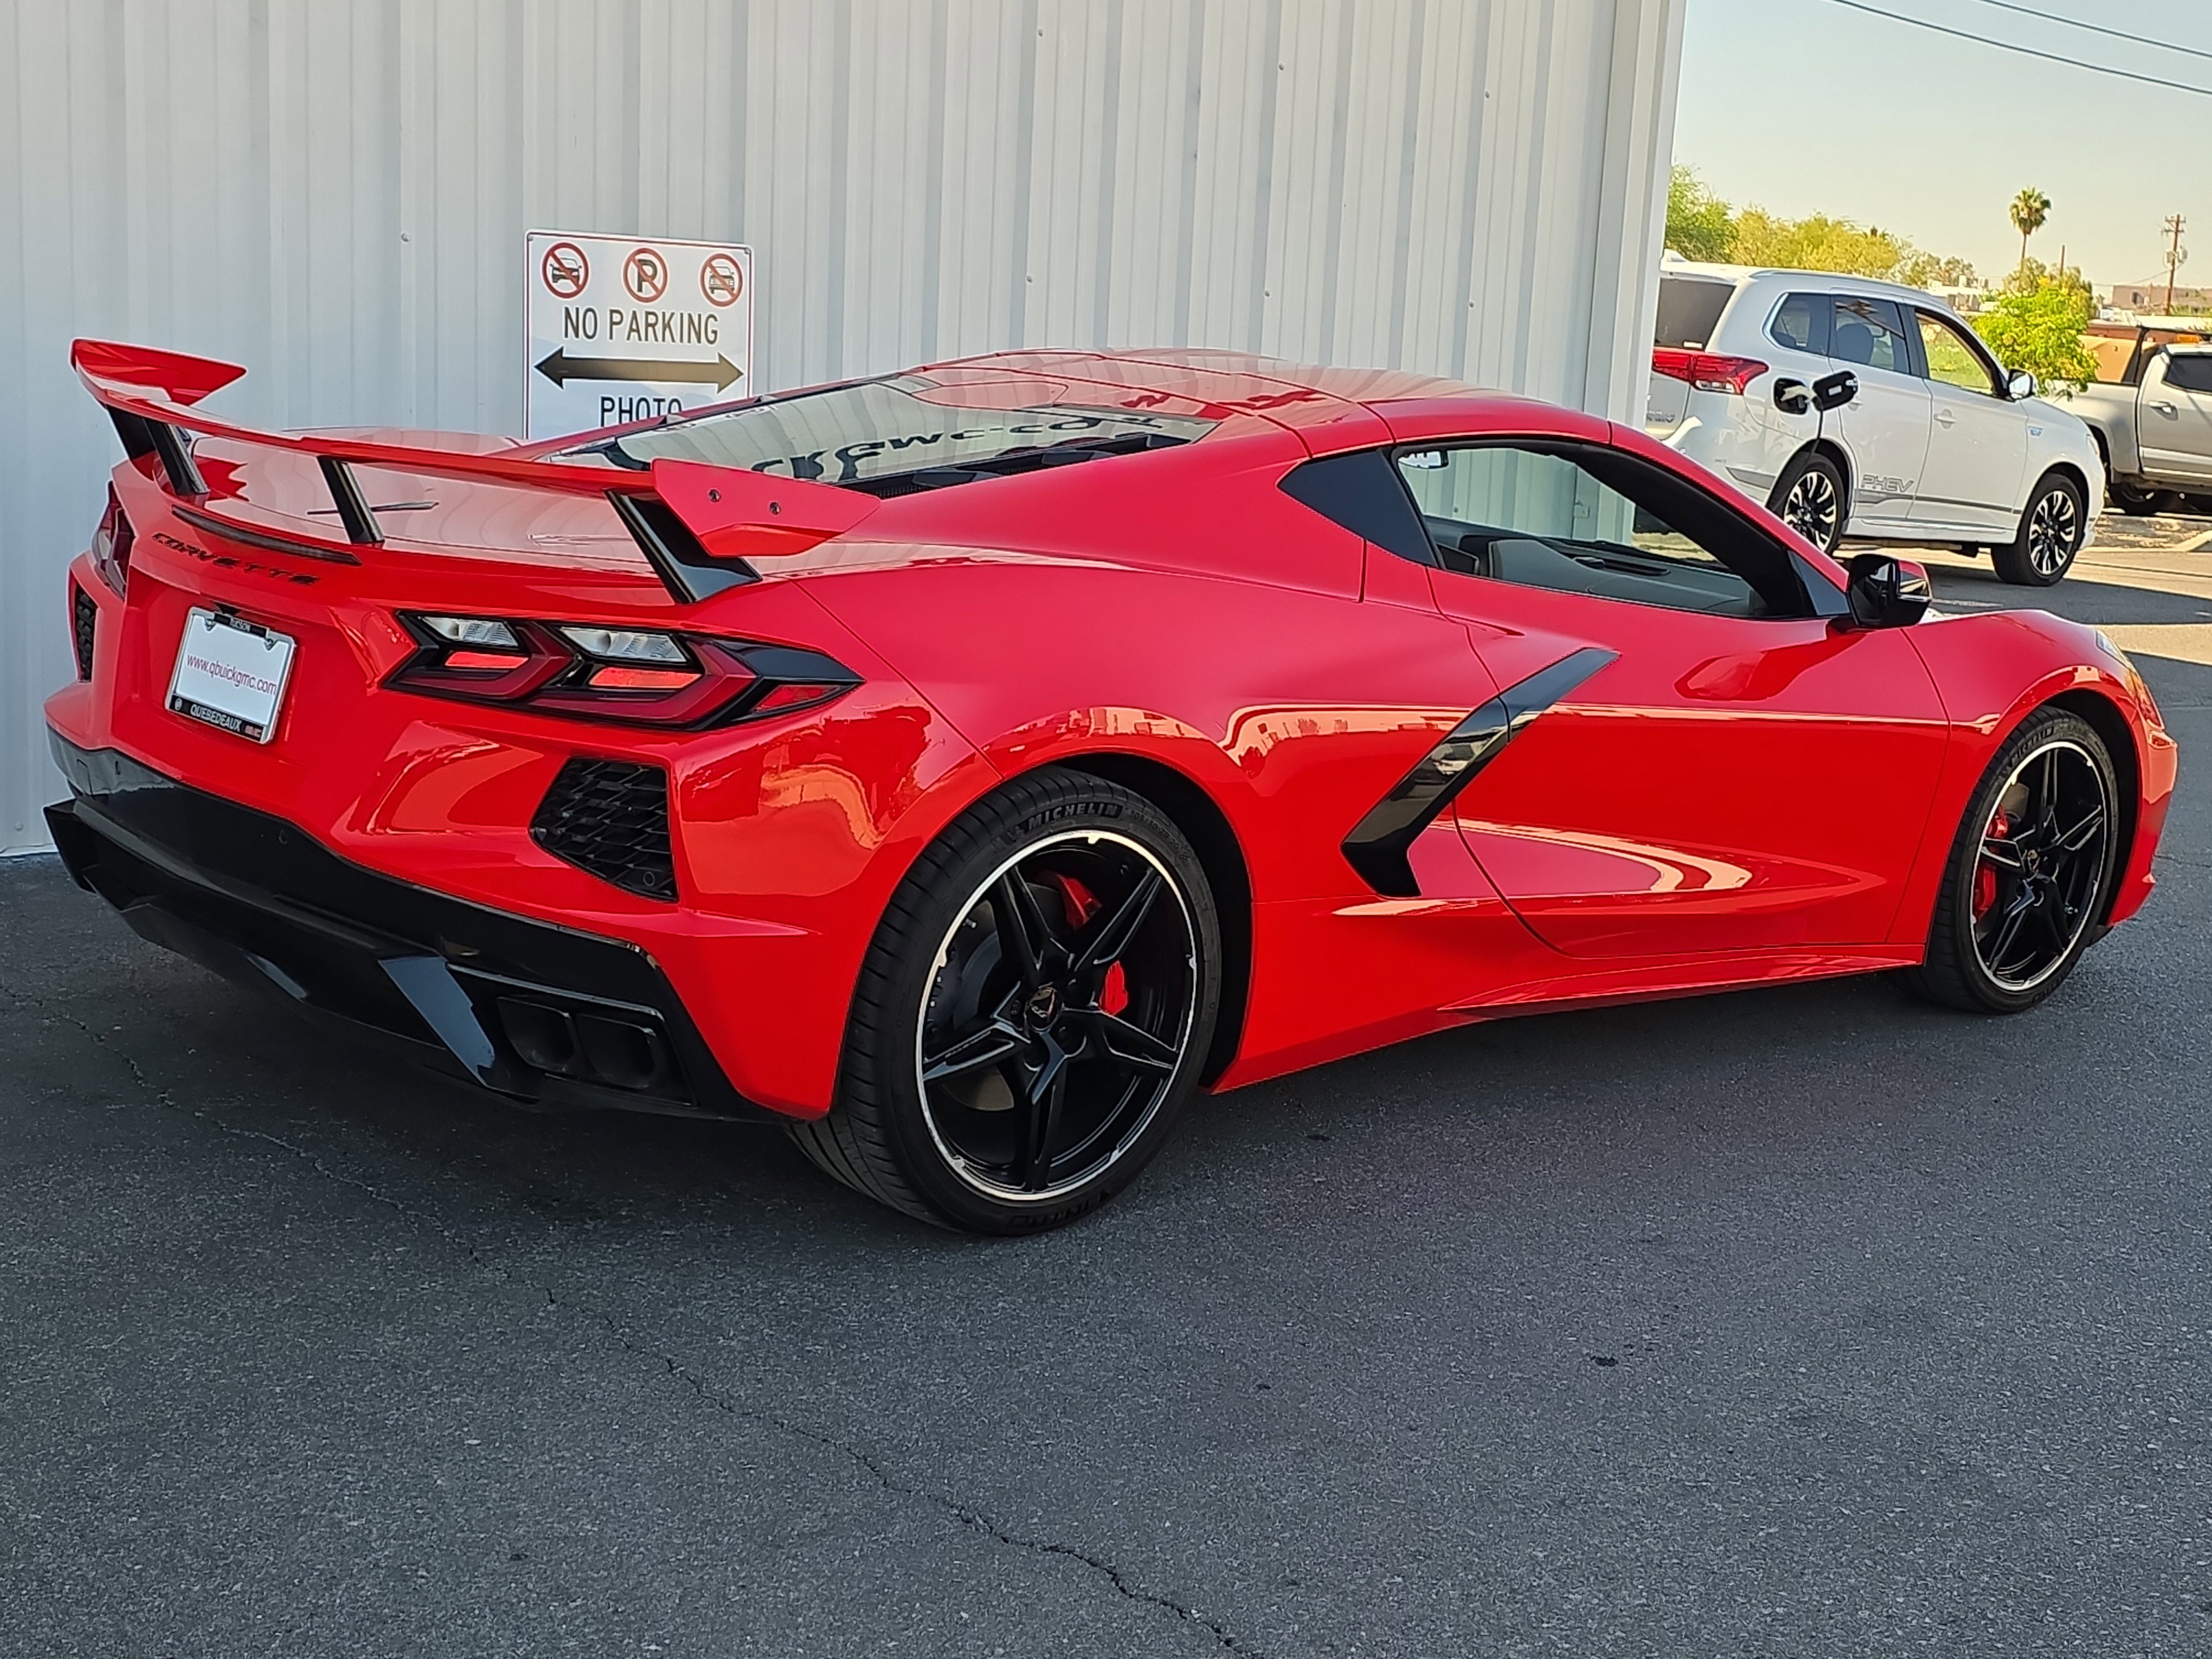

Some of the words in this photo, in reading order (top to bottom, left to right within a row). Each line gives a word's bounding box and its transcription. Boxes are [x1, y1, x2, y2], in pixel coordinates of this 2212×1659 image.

[563, 307, 597, 340] NO
[608, 308, 718, 344] PARKING
[1861, 474, 1914, 493] PHEV
[151, 532, 321, 585] CORVETTE
[187, 654, 277, 696] www.qbuickgmc.com
[190, 704, 242, 732] QUEBEDEAUX
[1027, 802, 1119, 829] MICHELIN
